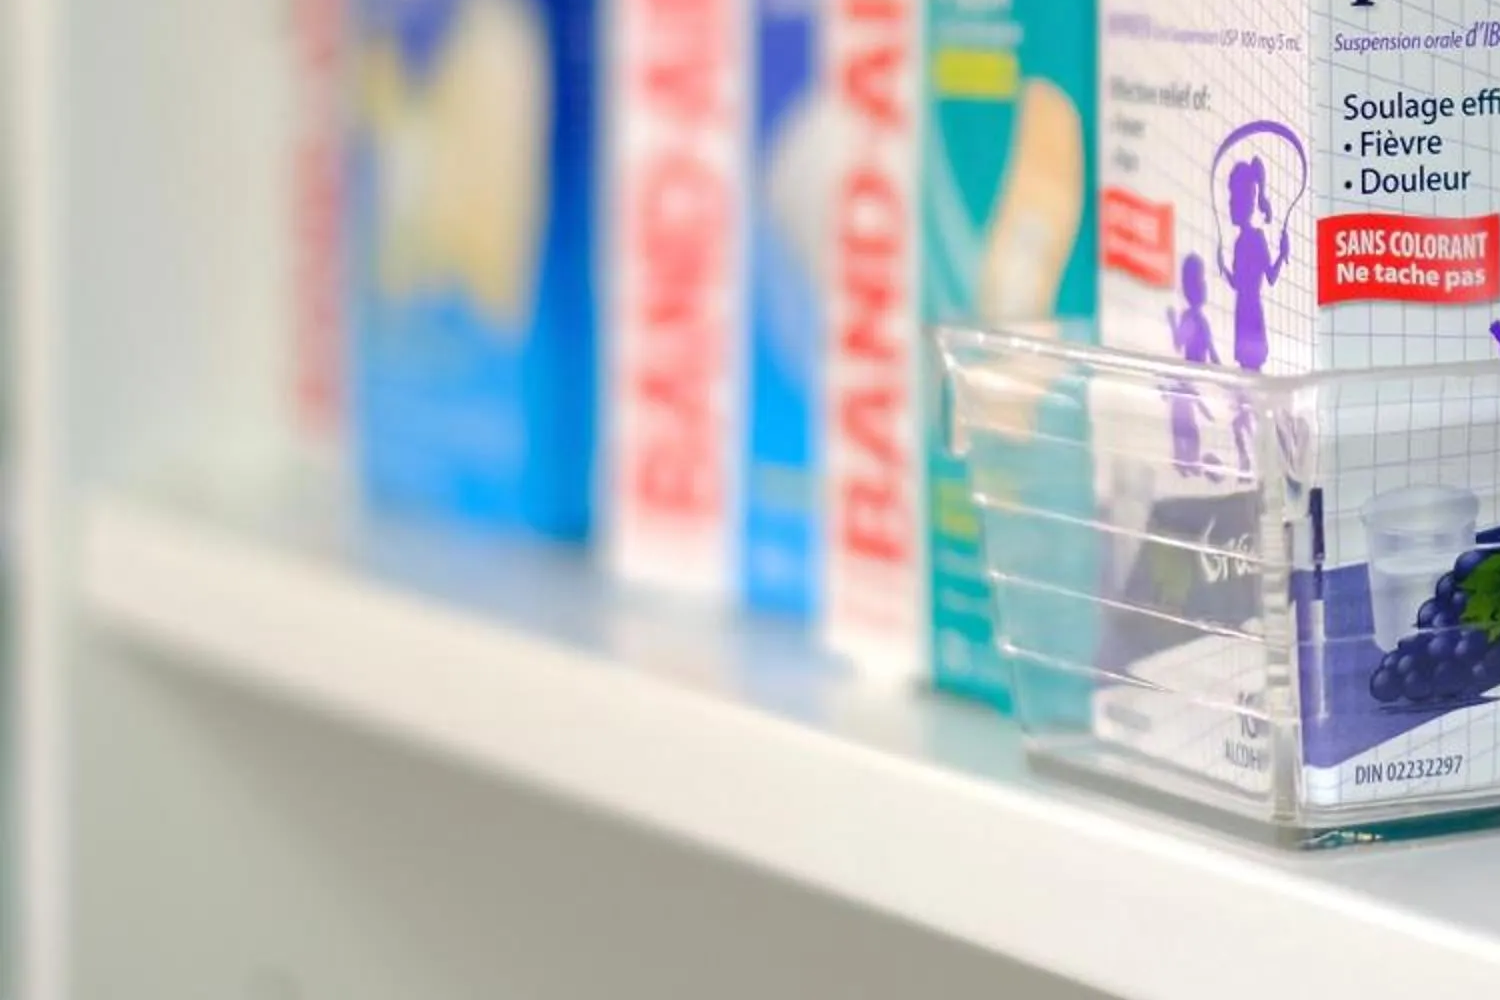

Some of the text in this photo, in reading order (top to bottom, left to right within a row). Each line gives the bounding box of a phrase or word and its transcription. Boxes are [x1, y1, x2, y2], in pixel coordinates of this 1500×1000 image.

[1334, 32, 1422, 56] Suspension
[1423, 30, 1463, 50] orale
[1344, 91, 1455, 125] Soulage
[1360, 128, 1443, 158] Fièvre
[1361, 165, 1472, 195] Douleur
[1335, 229, 1489, 261] SANS COLORANT
[1336, 262, 1487, 293] Ne tache pas
[1355, 754, 1463, 785] DIN 02232297
